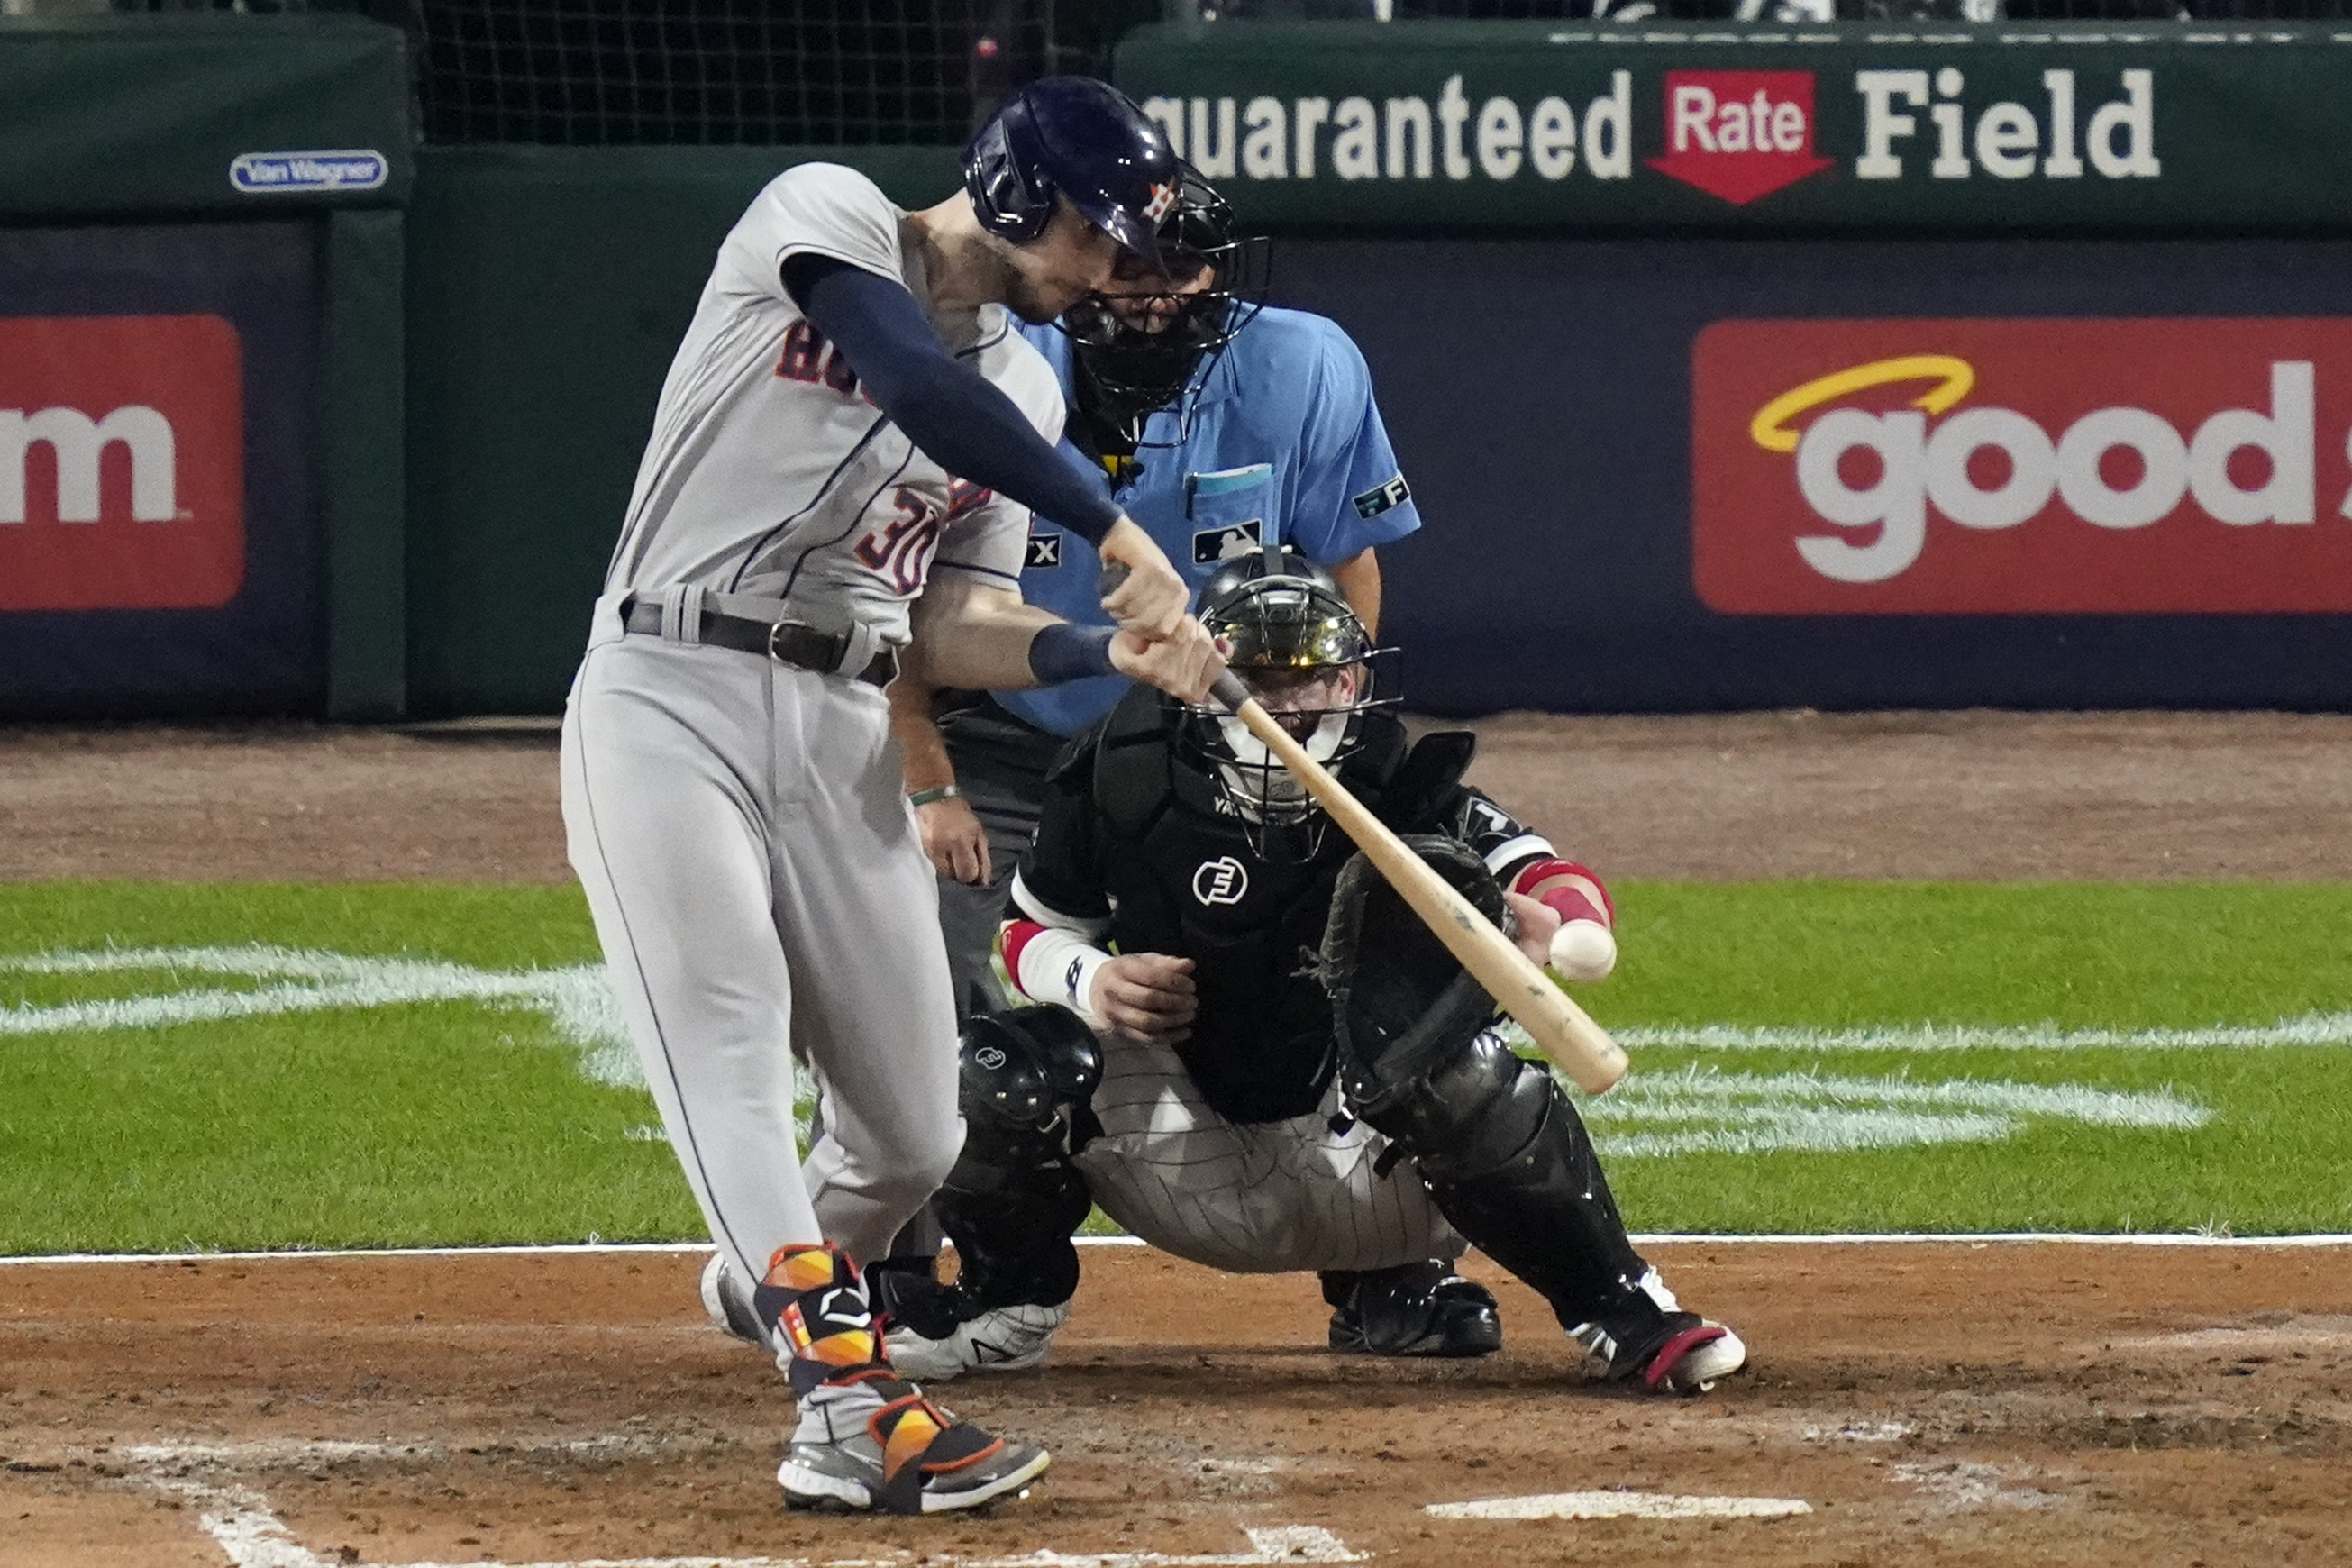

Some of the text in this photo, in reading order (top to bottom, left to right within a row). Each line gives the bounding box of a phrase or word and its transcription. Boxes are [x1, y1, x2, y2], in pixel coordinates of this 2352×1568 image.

[1672, 86, 1805, 152] Rate
[1855, 67, 2161, 179] Field
[1794, 360, 2316, 583] good
[854, 484, 941, 597] 30
[1028, 538, 1059, 565] X
